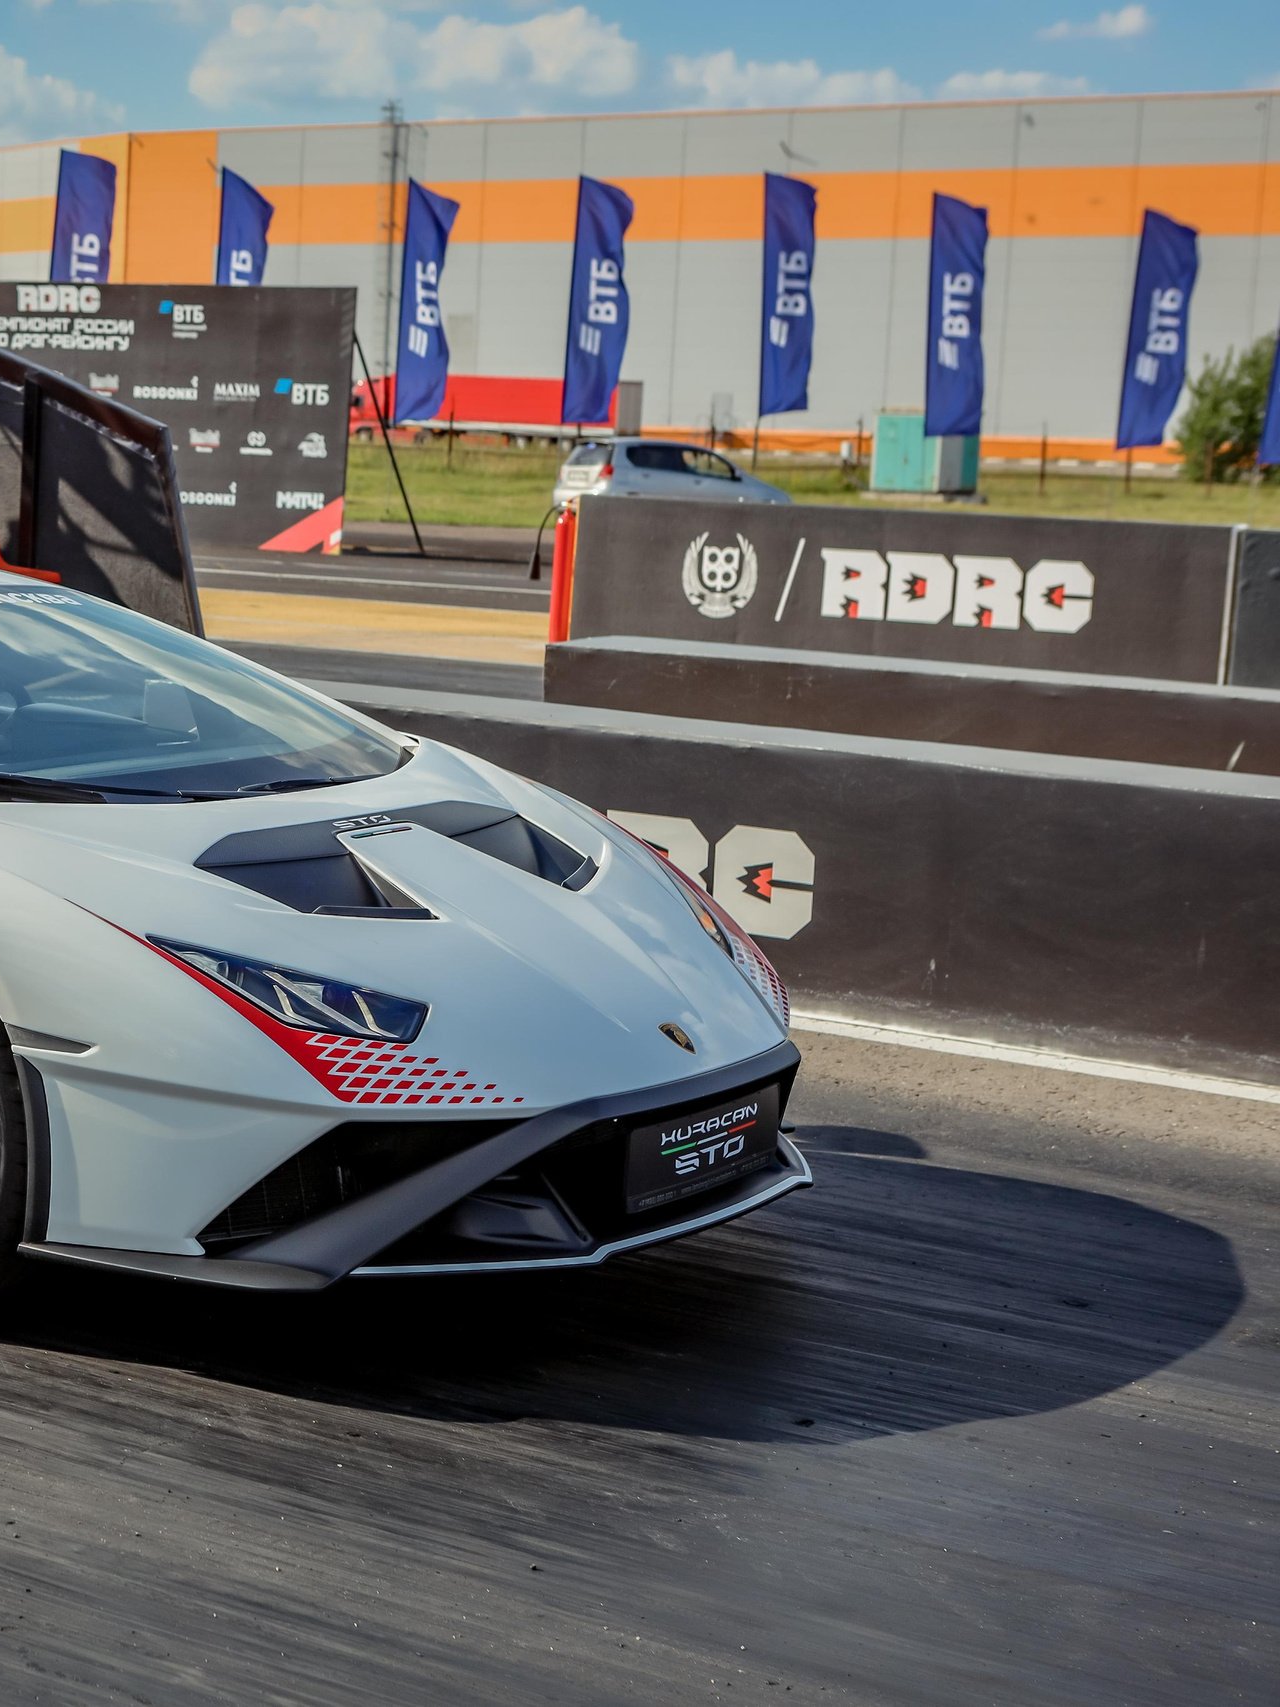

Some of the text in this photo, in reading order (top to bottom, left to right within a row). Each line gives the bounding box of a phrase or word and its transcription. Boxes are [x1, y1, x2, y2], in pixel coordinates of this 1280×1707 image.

[16, 284, 102, 313] RDRC
[415, 260, 440, 326] ВТБ
[587, 258, 619, 324] ВТБ
[776, 250, 808, 317] ВТБ
[173, 304, 205, 323] ВТБ
[942, 272, 974, 338] ВТБ
[1145, 287, 1184, 355] ВТБ
[11, 331, 130, 351] ДРЭГ-РЕЙСИНГУ
[73, 318, 135, 334] РОССИИ
[214, 382, 260, 397] MAXIM
[291, 383, 330, 406] ВТБ
[820, 547, 1095, 634] RDRC
[332, 815, 391, 828] STO
[675, 1134, 745, 1175] STO
